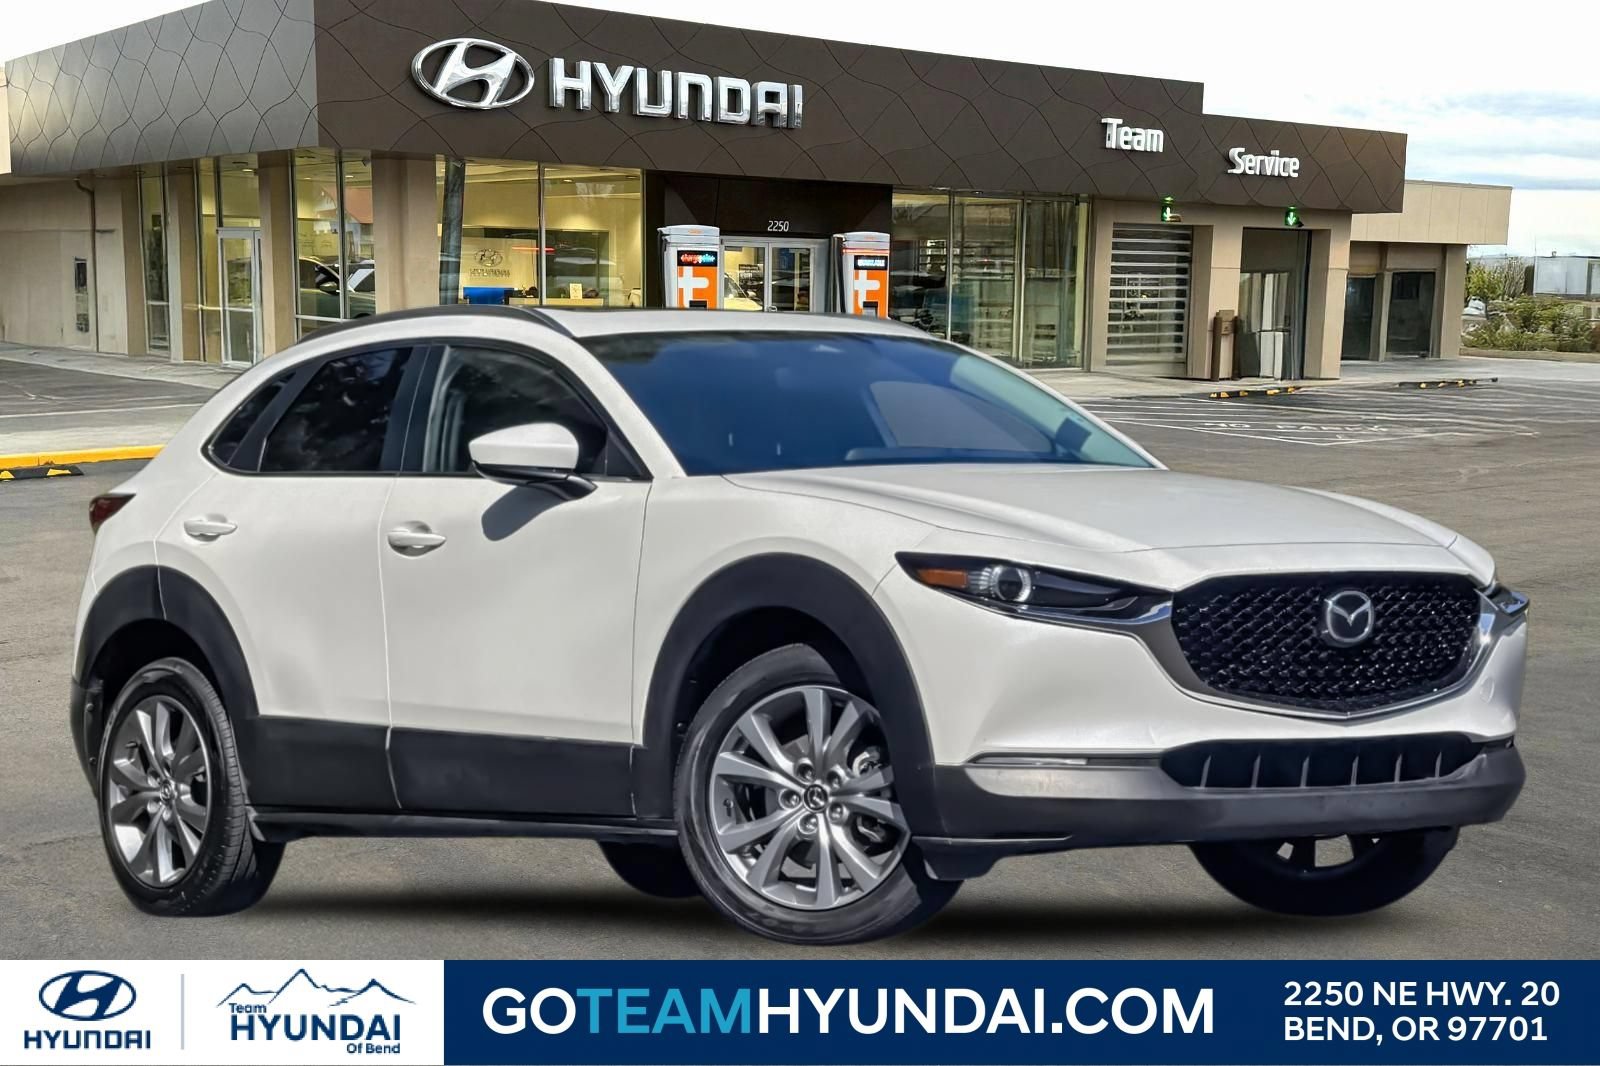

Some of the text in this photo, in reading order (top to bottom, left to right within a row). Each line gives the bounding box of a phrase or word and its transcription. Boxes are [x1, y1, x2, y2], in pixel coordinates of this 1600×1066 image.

[549, 57, 803, 129] HYUNDAI
[1101, 117, 1164, 152] Team
[1227, 147, 1300, 177] Service
[767, 220, 790, 231] 2250
